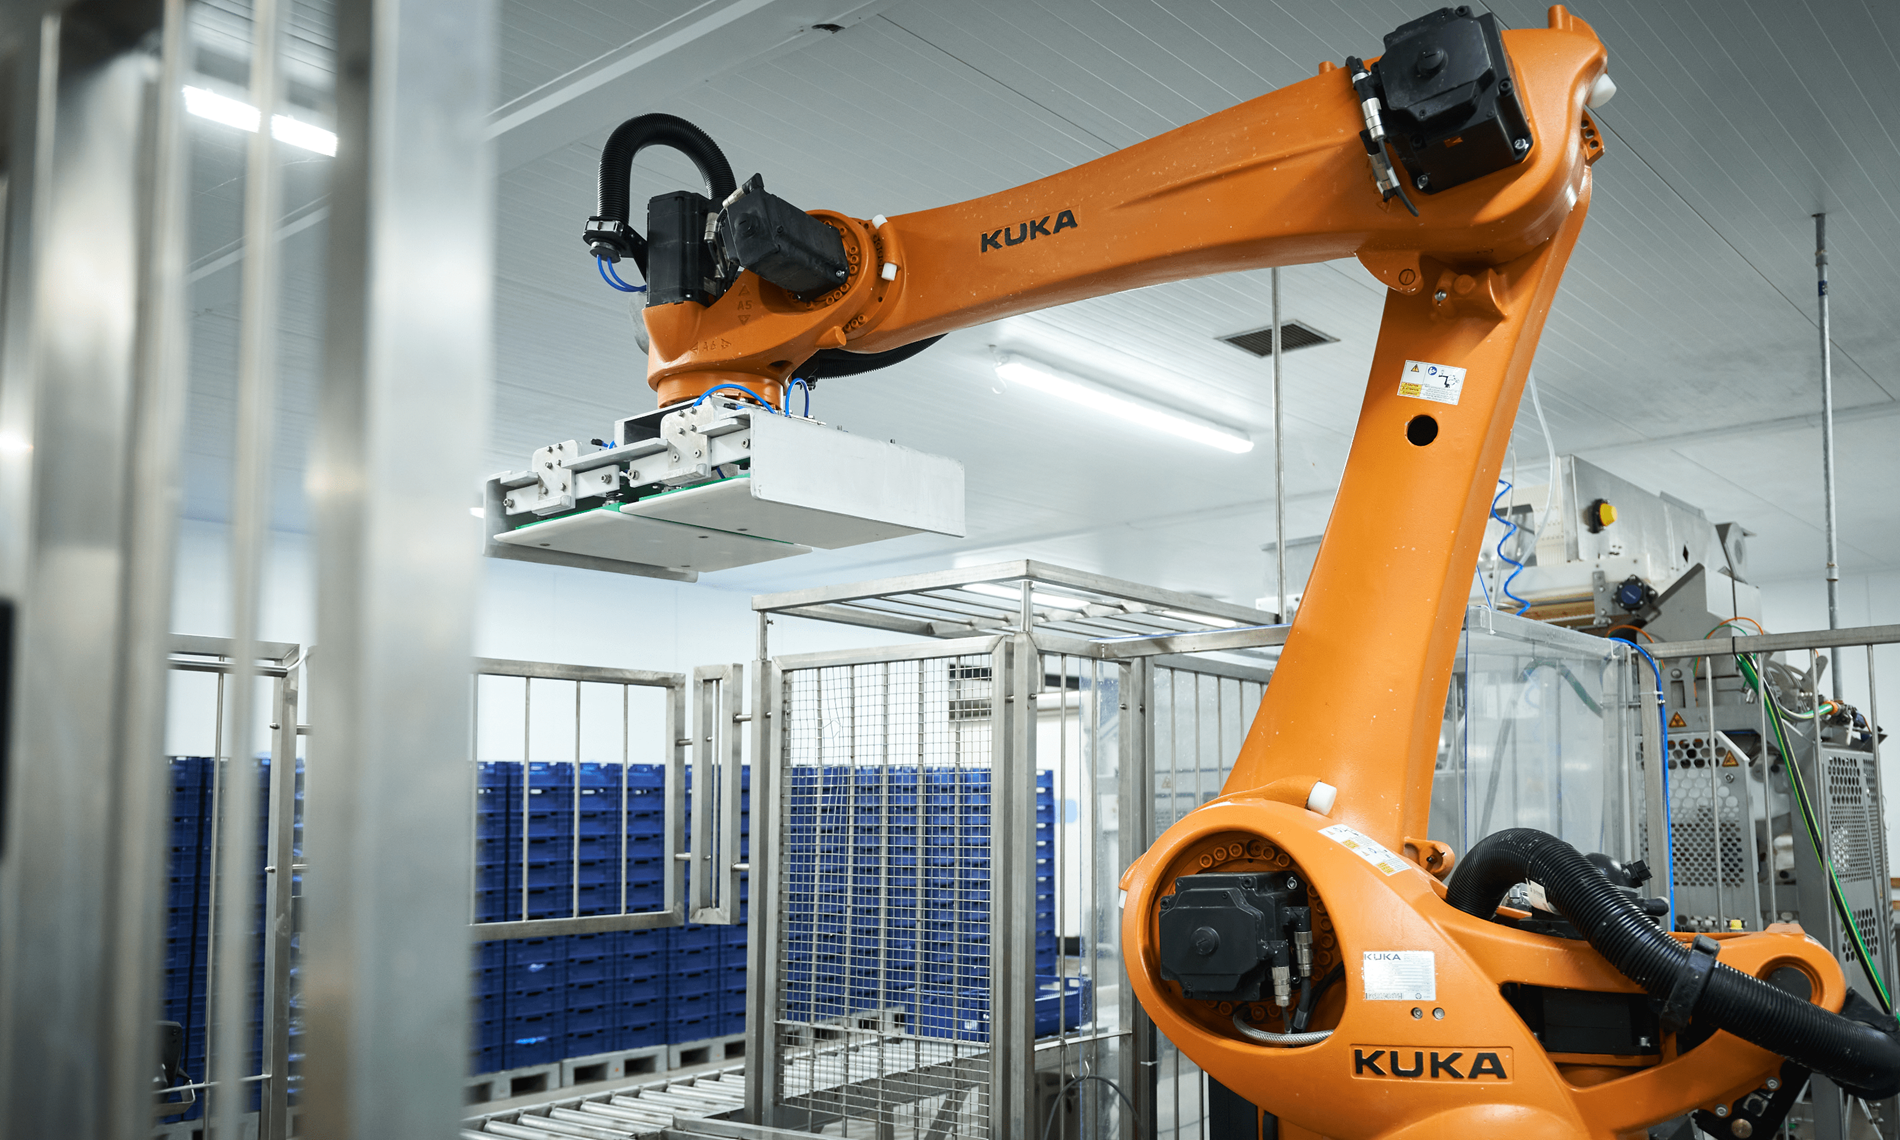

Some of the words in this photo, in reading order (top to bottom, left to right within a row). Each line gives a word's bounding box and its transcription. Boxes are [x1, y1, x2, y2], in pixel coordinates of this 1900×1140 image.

[981, 209, 1078, 253] KUKA
[737, 300, 752, 310] A5
[702, 341, 716, 351] A6
[1364, 953, 1402, 961] KUKA
[1354, 1049, 1508, 1079] KUKA
